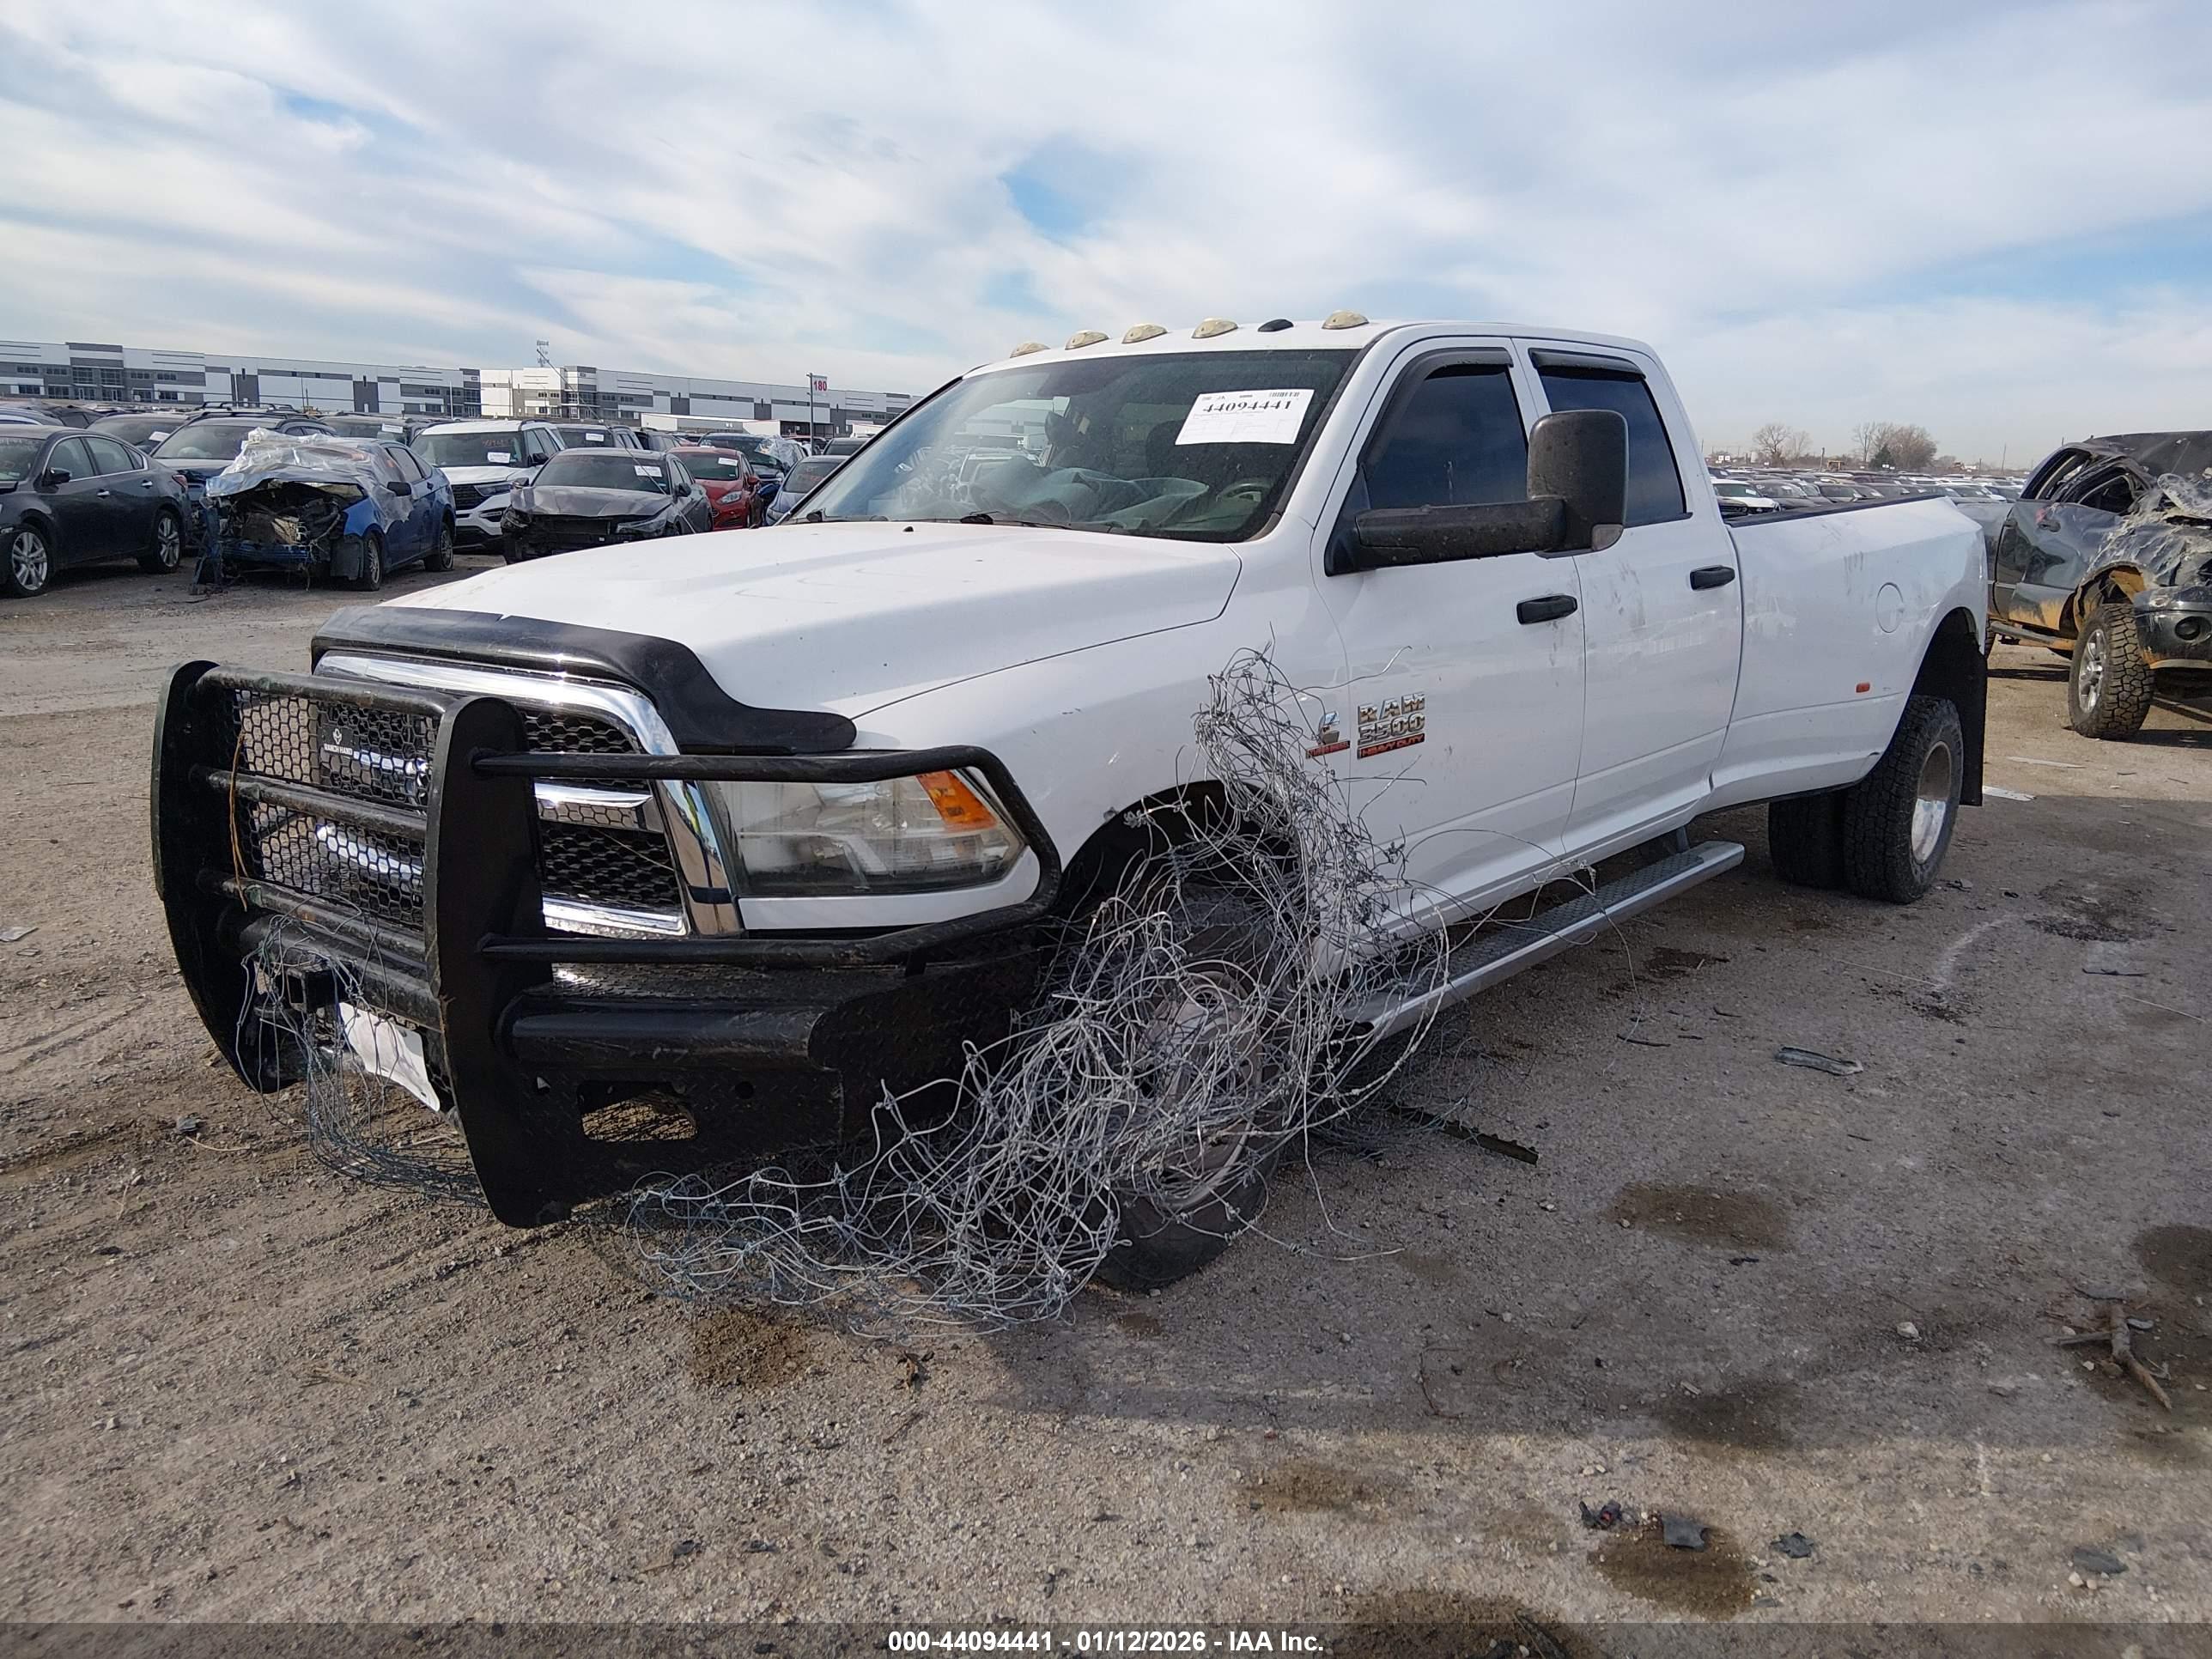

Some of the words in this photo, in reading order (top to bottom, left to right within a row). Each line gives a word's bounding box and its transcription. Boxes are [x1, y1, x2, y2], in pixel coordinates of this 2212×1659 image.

[813, 380, 828, 392] 180
[1202, 400, 1291, 413] 44094441
[1358, 692, 1425, 725] RAM
[1362, 741, 1396, 757] HEAVY
[1396, 734, 1424, 749] DUTY
